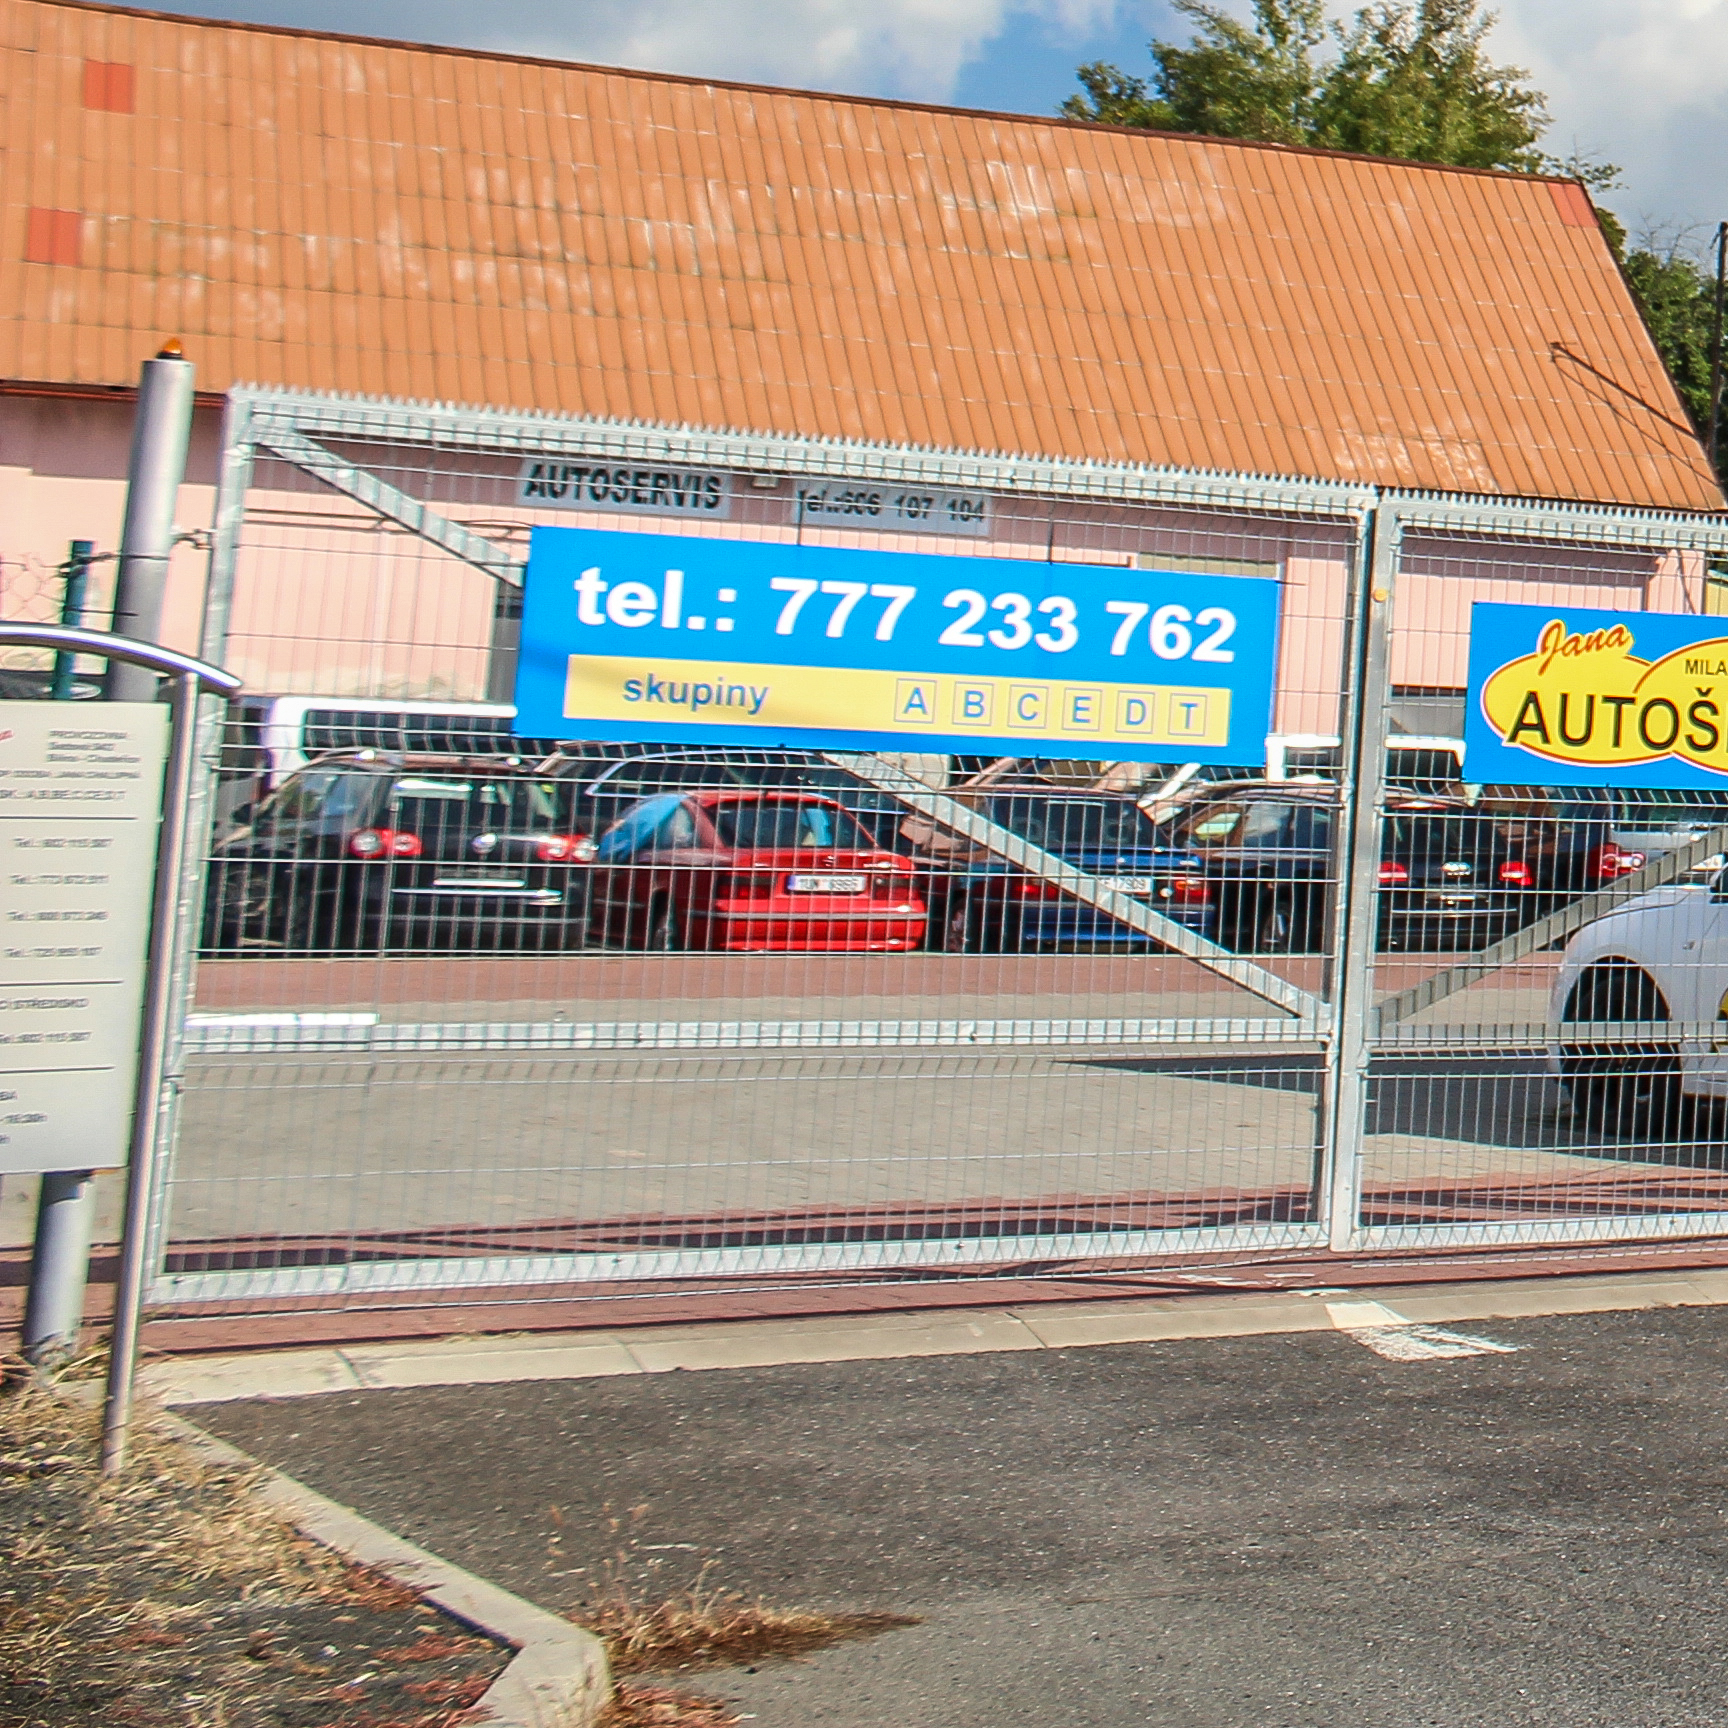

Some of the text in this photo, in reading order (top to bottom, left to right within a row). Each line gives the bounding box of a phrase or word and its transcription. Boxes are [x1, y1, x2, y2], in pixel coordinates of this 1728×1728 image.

[524, 463, 722, 510] AUTOSERVIS
[895, 493, 934, 521] 107
[946, 496, 985, 524] 104
[574, 567, 1237, 663] tel.: 777 233 762
[1536, 620, 1632, 677] Jana
[623, 673, 1199, 730] skupiny A B C E D T
